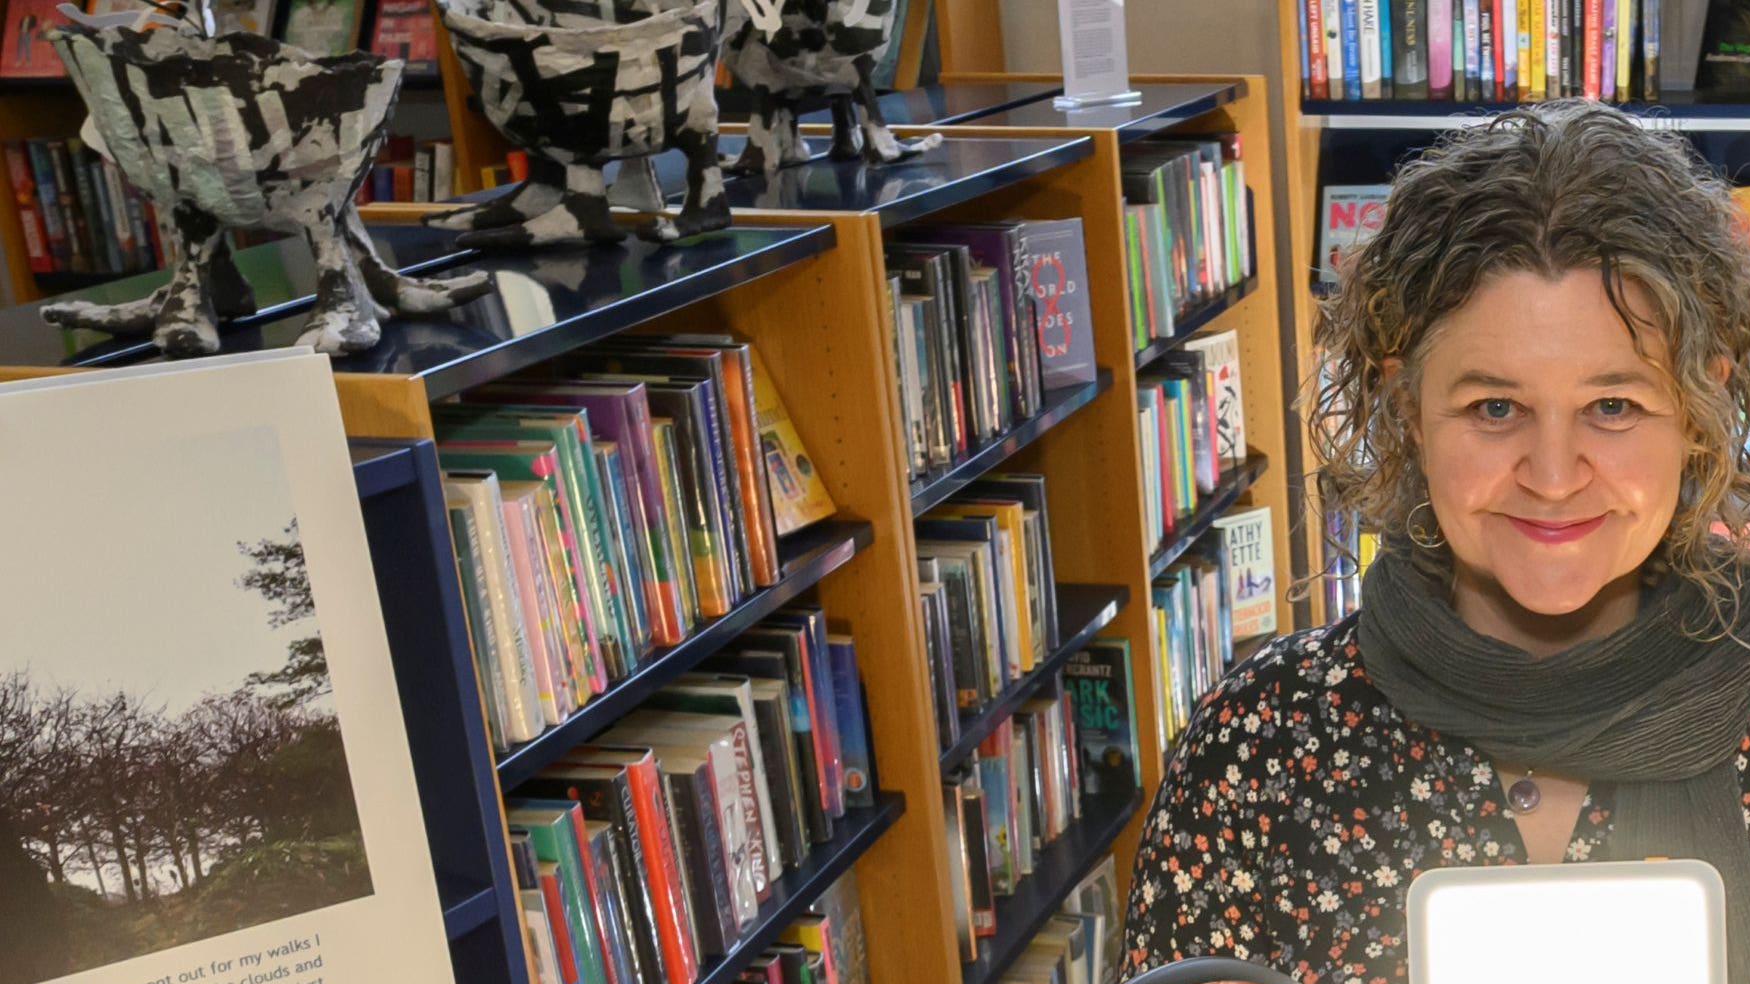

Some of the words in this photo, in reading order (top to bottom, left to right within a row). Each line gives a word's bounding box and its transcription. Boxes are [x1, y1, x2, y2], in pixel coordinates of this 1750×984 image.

[734, 727, 758, 823] STEPHEN
[178, 966, 206, 983] out
[210, 959, 232, 975] for
[239, 952, 262, 967] my
[266, 939, 311, 958] walks
[314, 933, 320, 946] I
[295, 954, 323, 973] and
